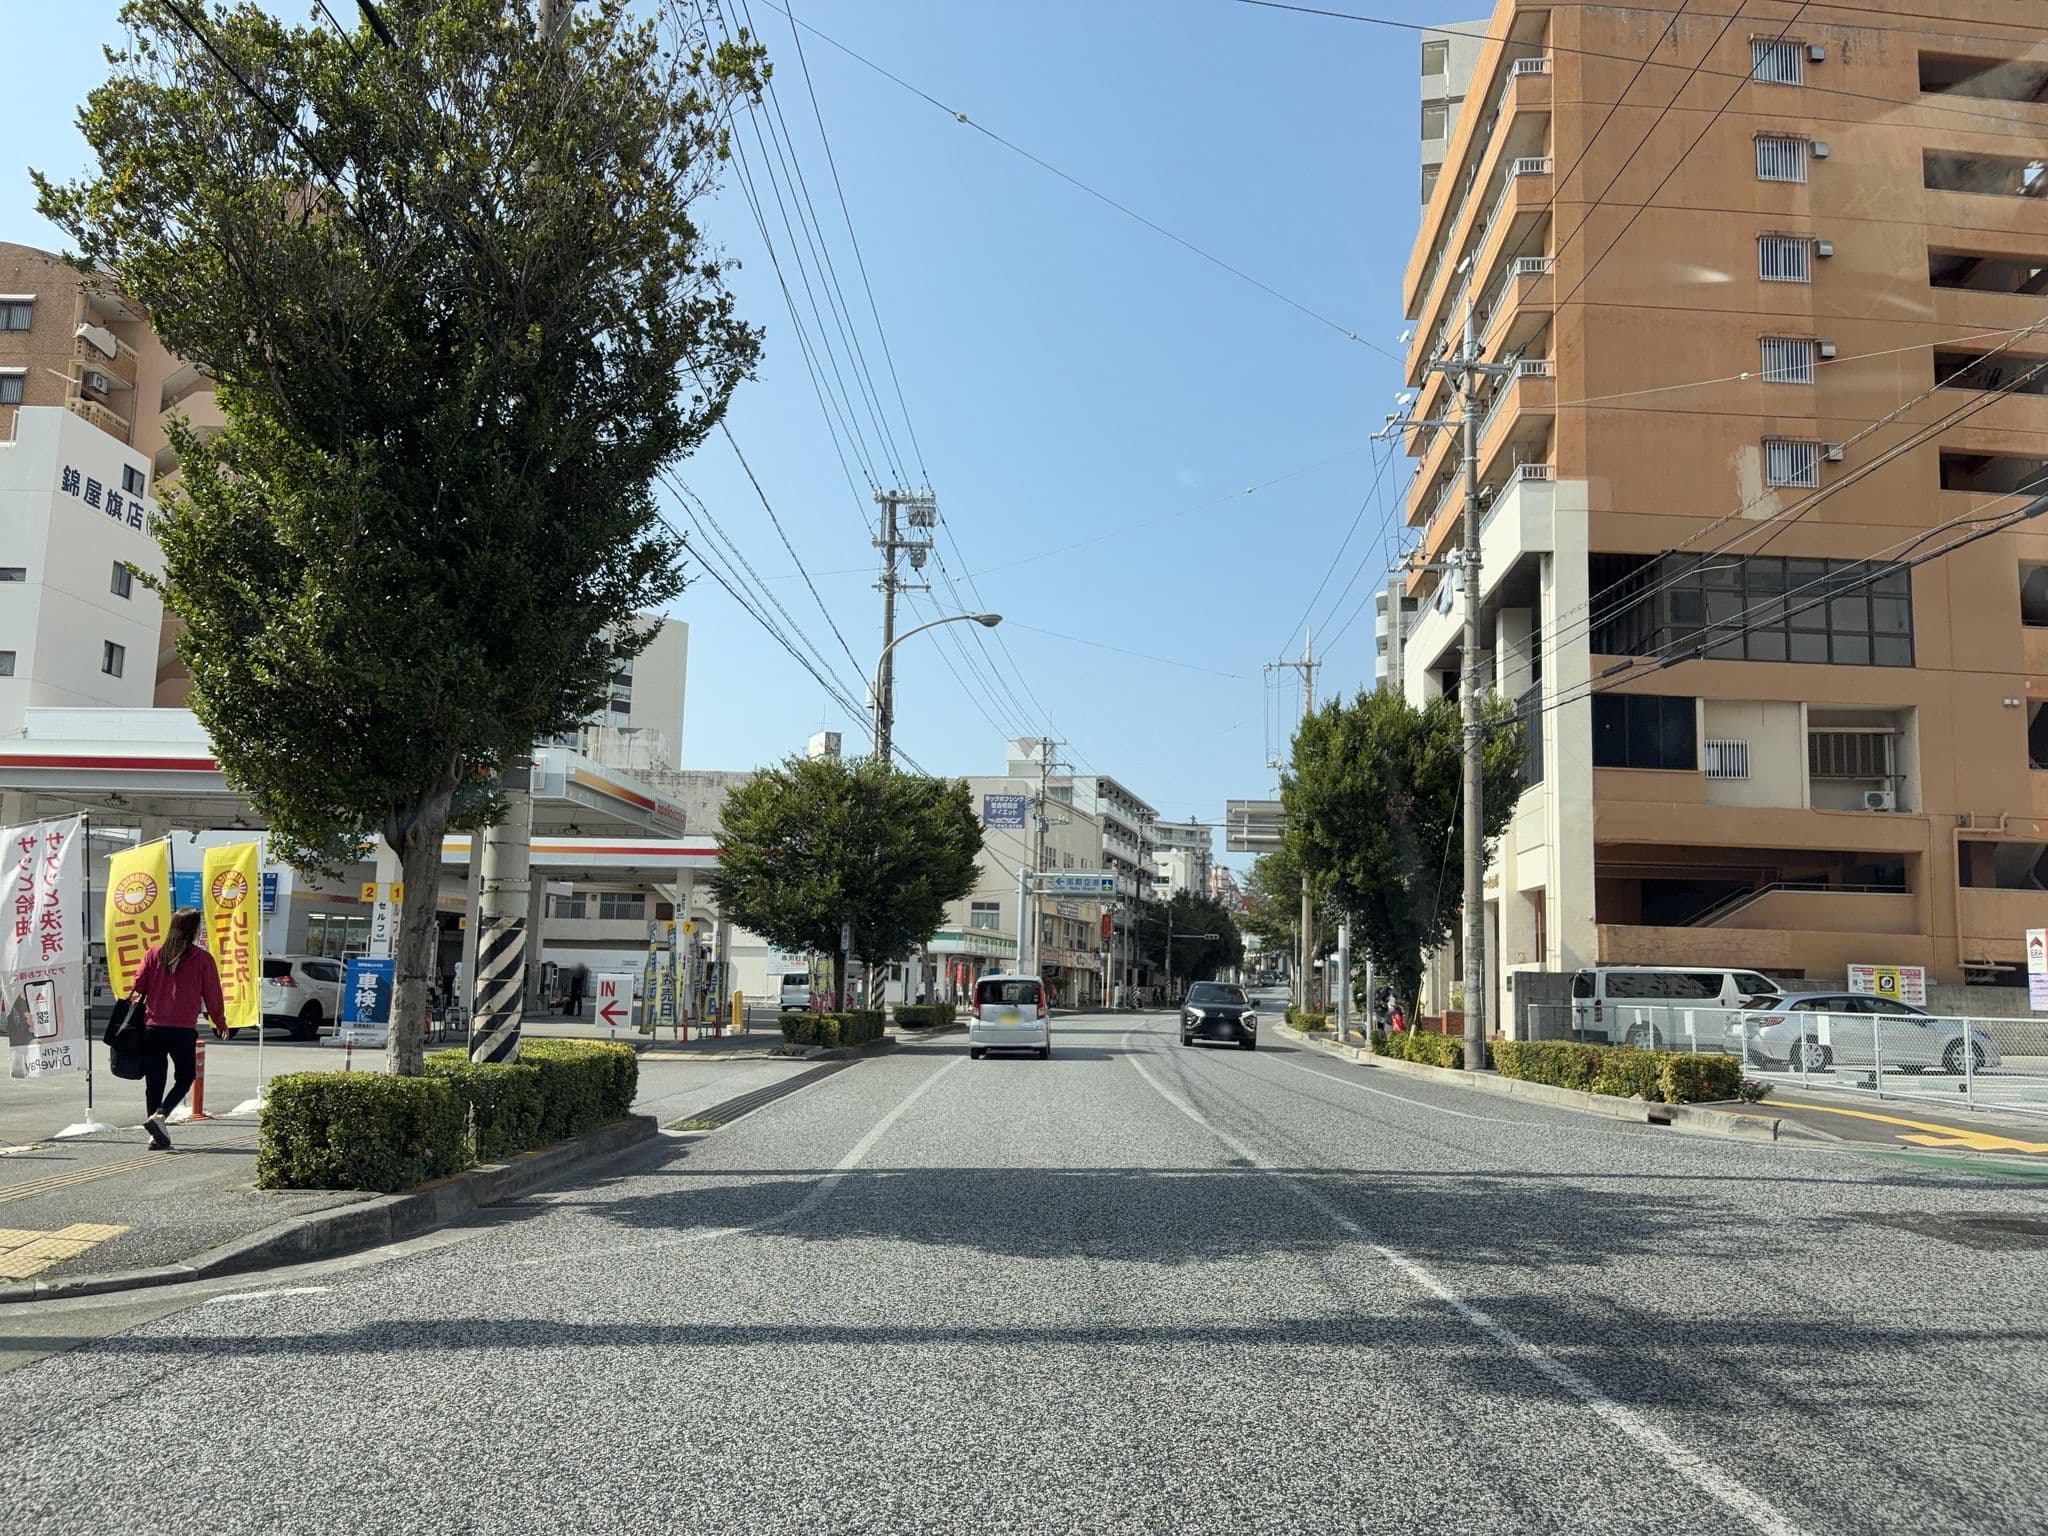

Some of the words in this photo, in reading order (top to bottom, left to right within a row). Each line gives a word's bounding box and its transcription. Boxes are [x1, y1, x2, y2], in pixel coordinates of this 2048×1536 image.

[366, 887, 374, 897] 2
[394, 887, 400, 898] 1
[376, 902, 387, 932] セルフ
[355, 973, 379, 1007] 車検
[600, 981, 616, 997] IN
